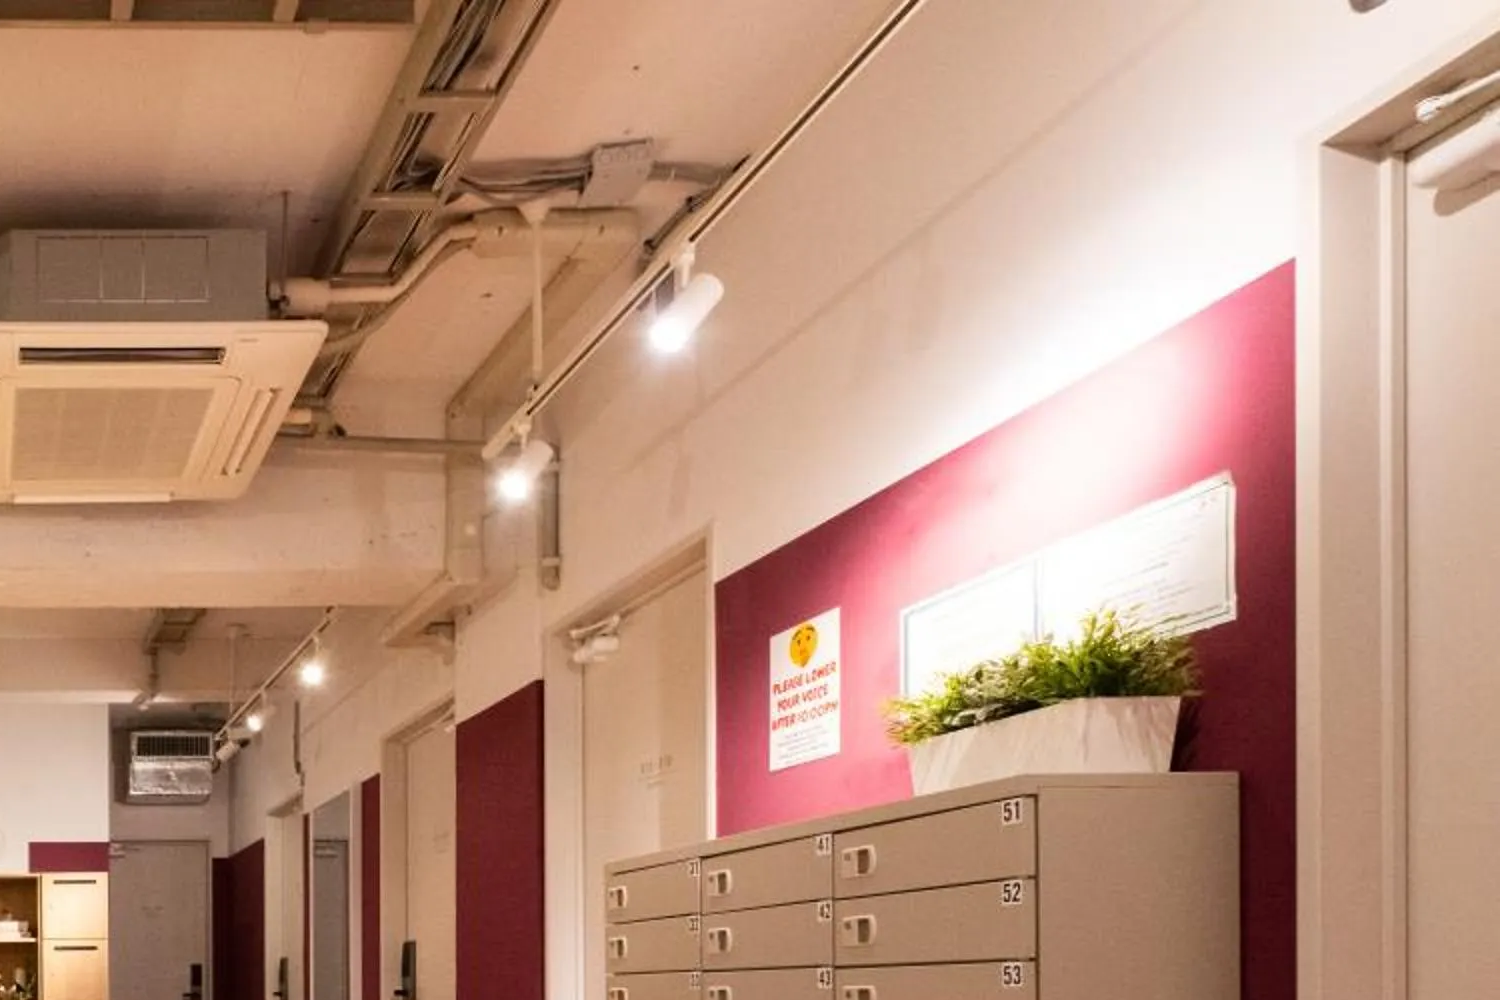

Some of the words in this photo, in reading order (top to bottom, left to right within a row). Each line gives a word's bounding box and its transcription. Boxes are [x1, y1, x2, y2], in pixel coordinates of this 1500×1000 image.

[802, 683, 828, 702] VOICE
[1004, 801, 1019, 822] 51
[1004, 882, 1020, 902] 52
[1003, 965, 1021, 985] 53
